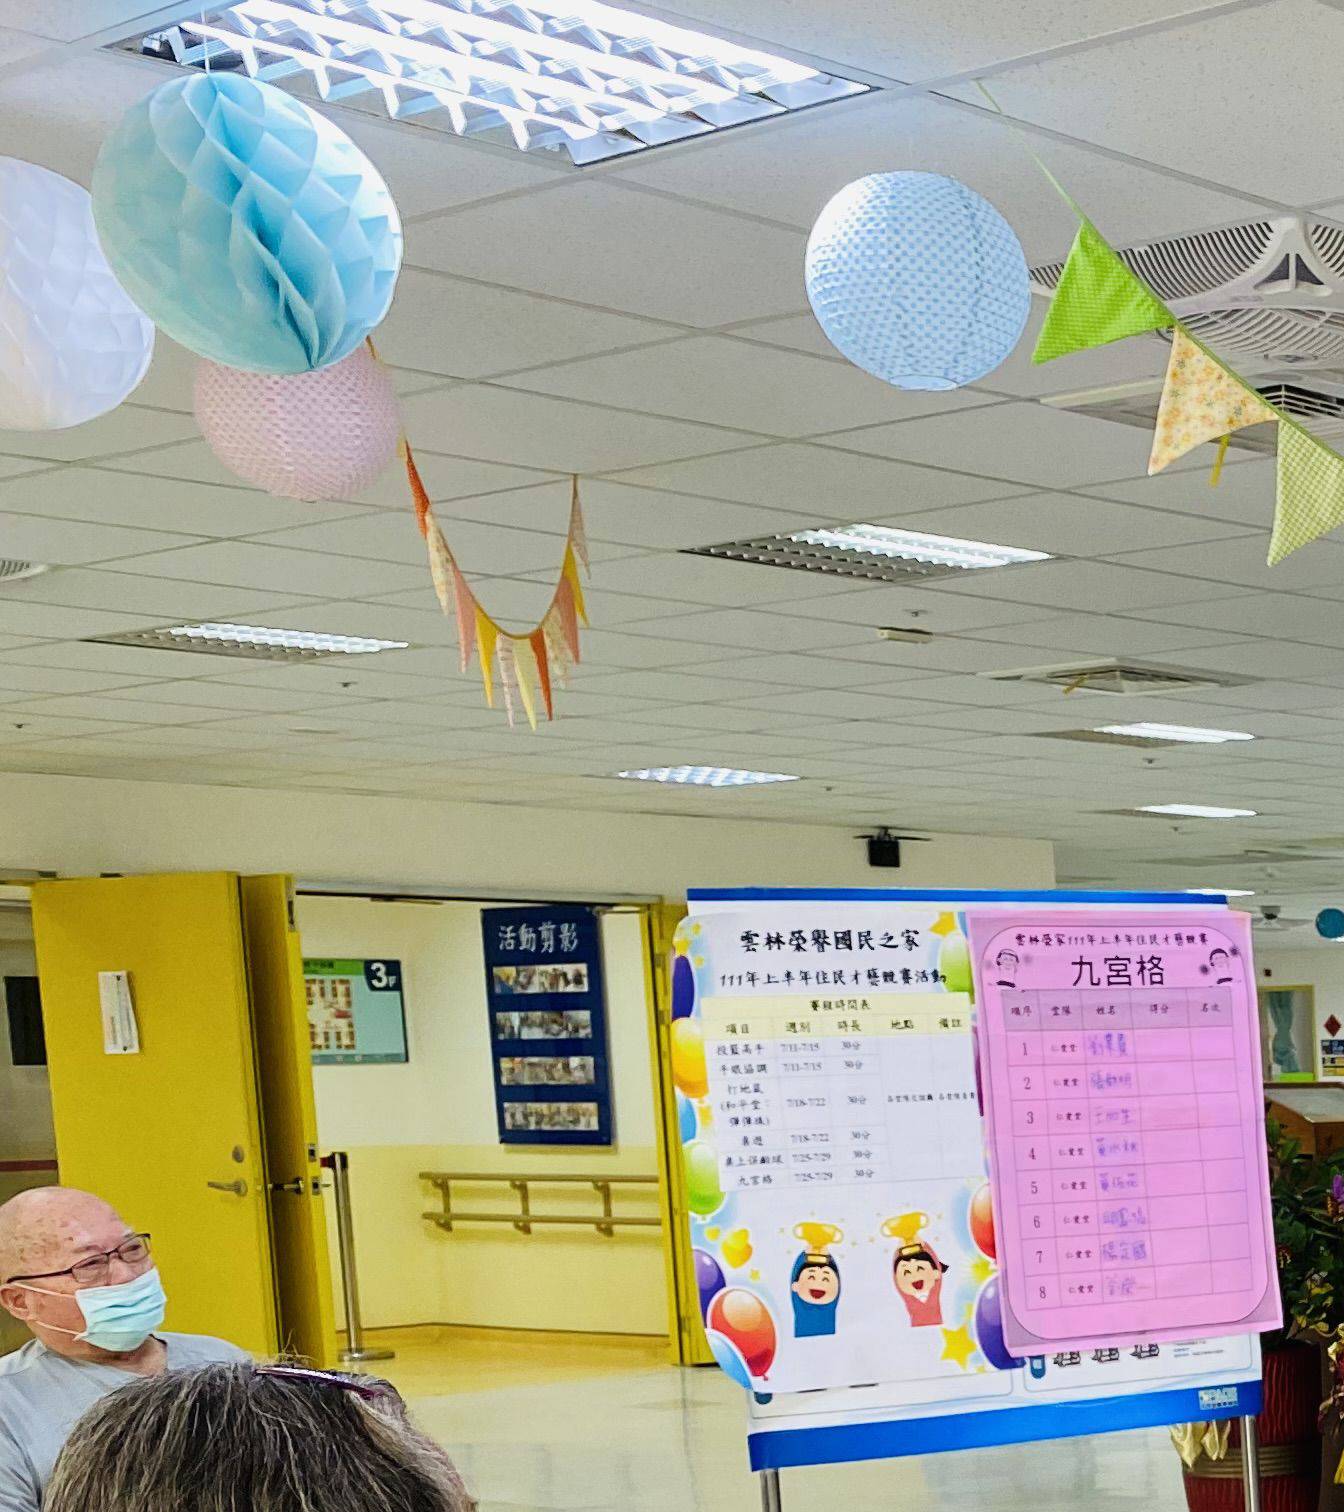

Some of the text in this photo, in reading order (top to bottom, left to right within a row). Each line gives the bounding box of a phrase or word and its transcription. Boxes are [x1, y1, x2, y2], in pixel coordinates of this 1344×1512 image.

[498, 920, 579, 953] 活動剪影
[739, 929, 921, 953] 雲林榮譽國民之家
[719, 967, 947, 988] 111年上半年住民才藝競賽活動
[1070, 955, 1165, 987] 九宮格
[1022, 1042, 1028, 1056] 1
[1023, 1076, 1031, 1090] 2
[1026, 1111, 1034, 1125] 3
[1029, 1147, 1036, 1160] 4
[1031, 1181, 1038, 1194] 5
[1033, 1215, 1041, 1229] 6
[1036, 1250, 1043, 1264] 7
[1039, 1286, 1047, 1299] 8
